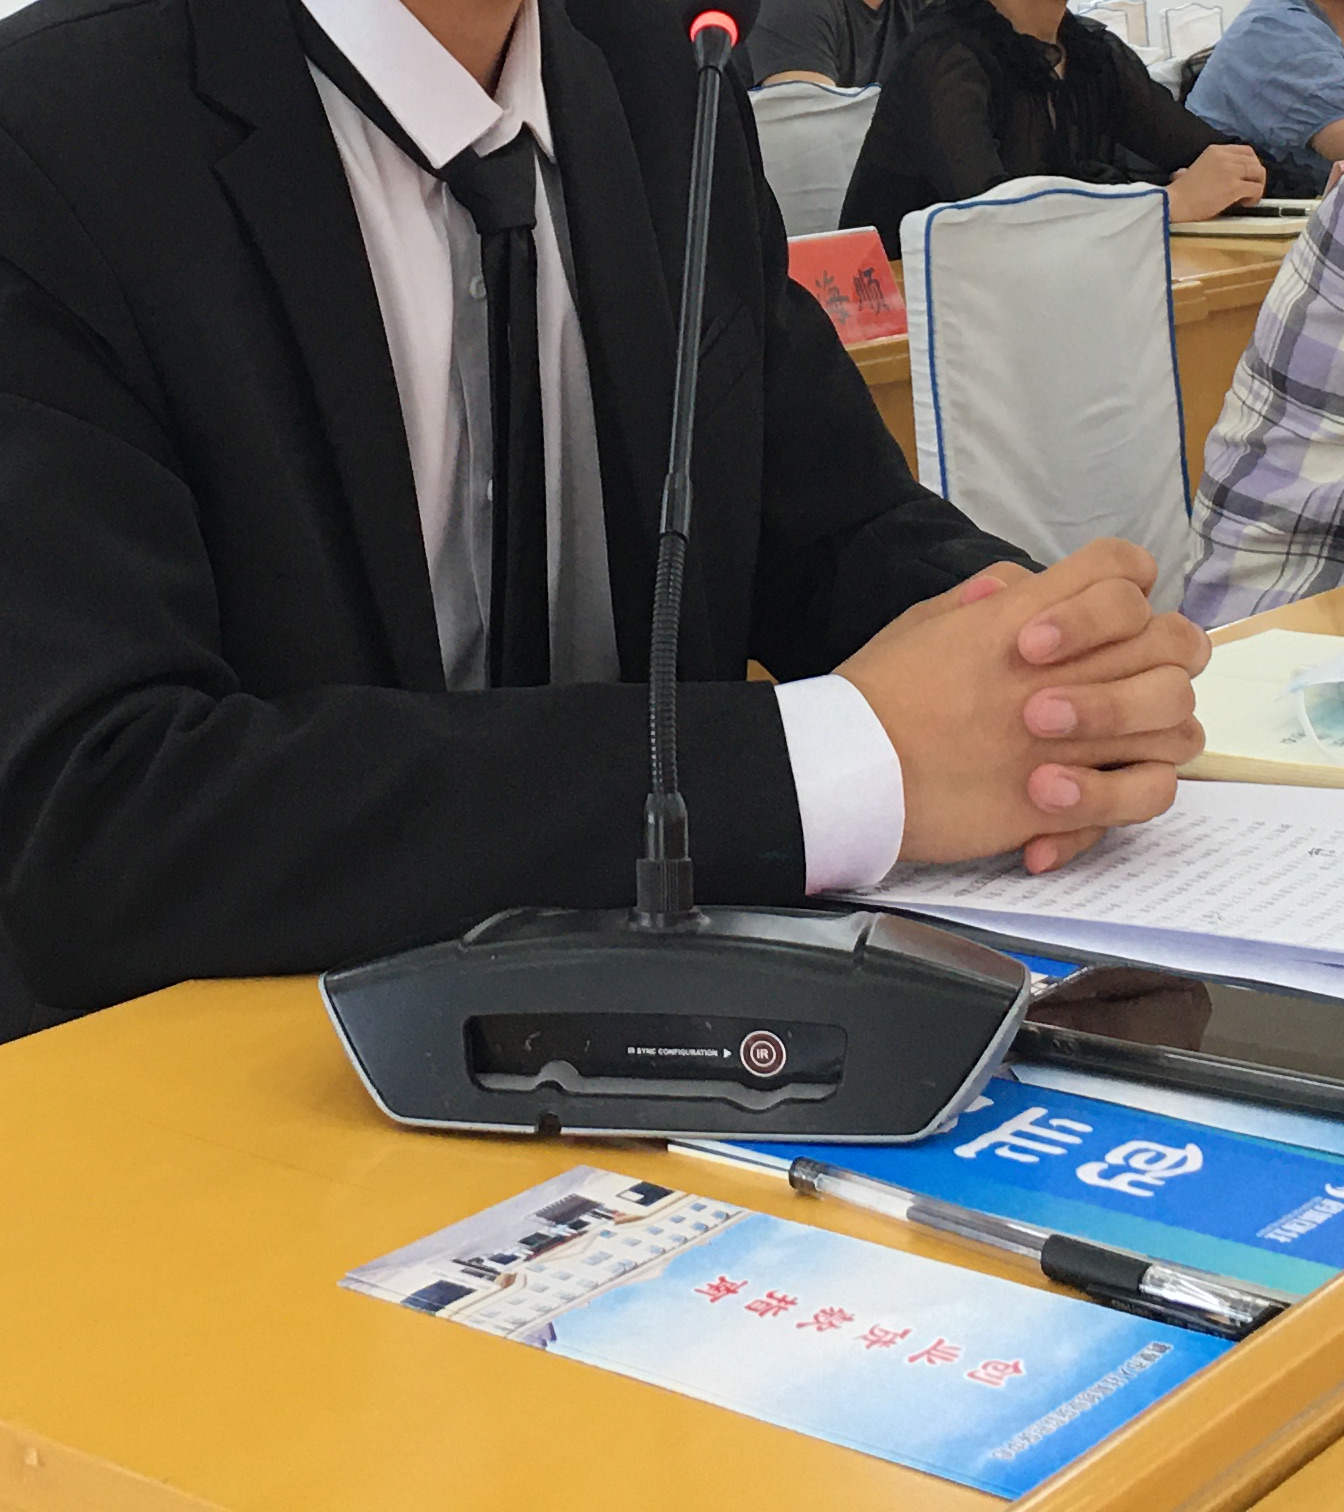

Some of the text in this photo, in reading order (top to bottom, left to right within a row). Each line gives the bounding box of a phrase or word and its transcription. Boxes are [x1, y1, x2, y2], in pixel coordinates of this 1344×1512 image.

[637, 1046, 656, 1055] SYNC
[658, 1047, 719, 1057] CONFIGURATION
[756, 1048, 769, 1059] IR
[938, 1095, 1204, 1198] 创业
[694, 1274, 1026, 1388] 创业贷款指南
